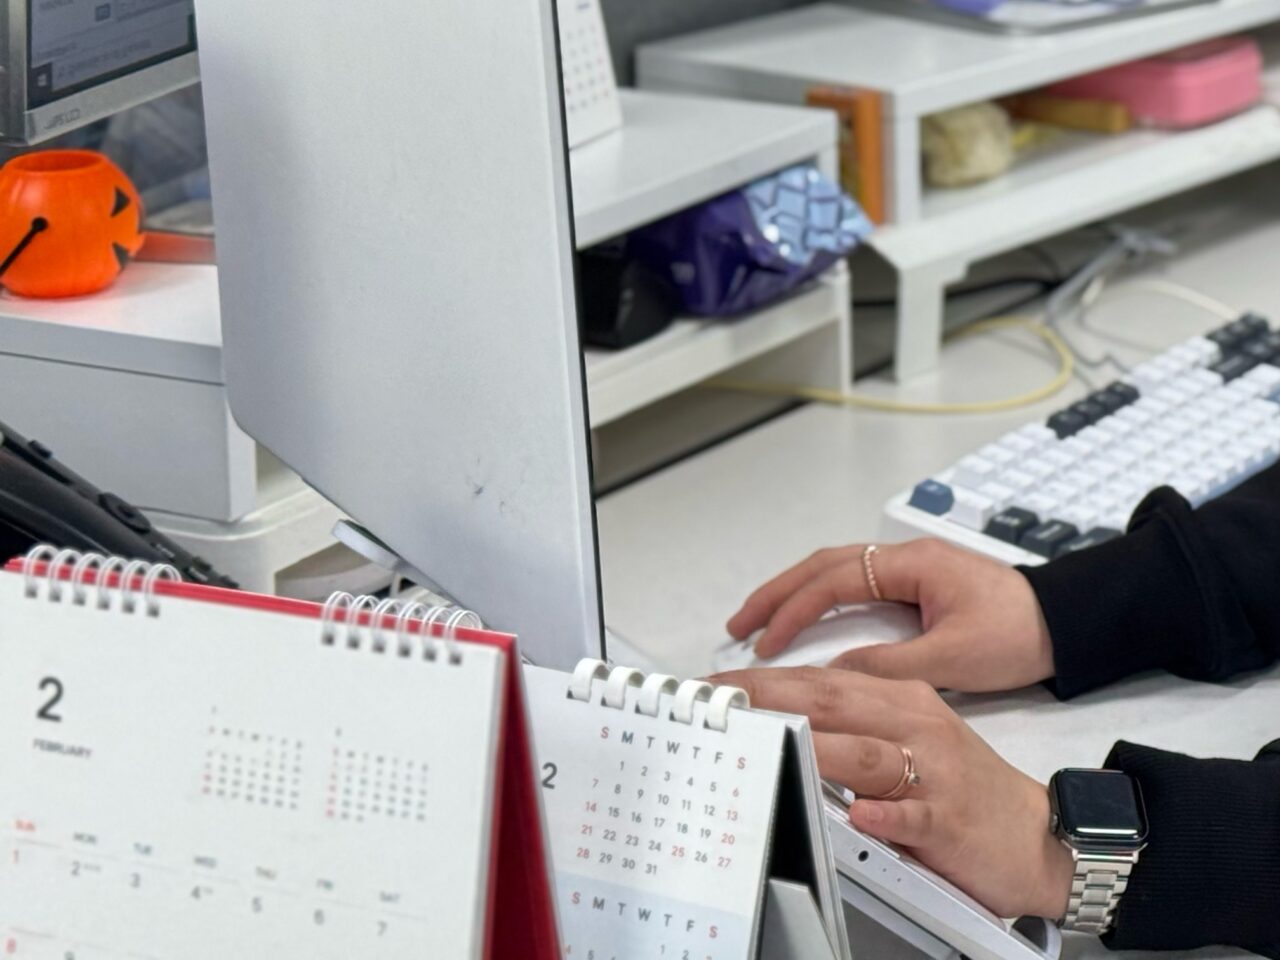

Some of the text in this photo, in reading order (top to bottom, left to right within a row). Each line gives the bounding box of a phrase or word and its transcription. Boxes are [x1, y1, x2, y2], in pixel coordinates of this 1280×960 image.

[36, 676, 64, 723] 2
[33, 738, 92, 758] FEBRUARY
[600, 726, 746, 771] S M T W T F S
[540, 761, 558, 790] 2
[619, 760, 740, 798] 1 2 3 4 5 6
[592, 777, 739, 822] 7 8 9 10 11 12 13
[580, 823, 732, 869] 21 22 23 24 25 26 27
[585, 801, 736, 846] 14 15 16 17 18 19 20
[576, 847, 658, 875] 28 29 30 31
[70, 860, 81, 877] 2
[130, 872, 142, 889] 3
[190, 885, 201, 900] 4
[251, 896, 263, 914] 5
[376, 920, 388, 937] 7
[571, 891, 718, 939] S M T W T F S
[660, 943, 690, 960] 1 2
